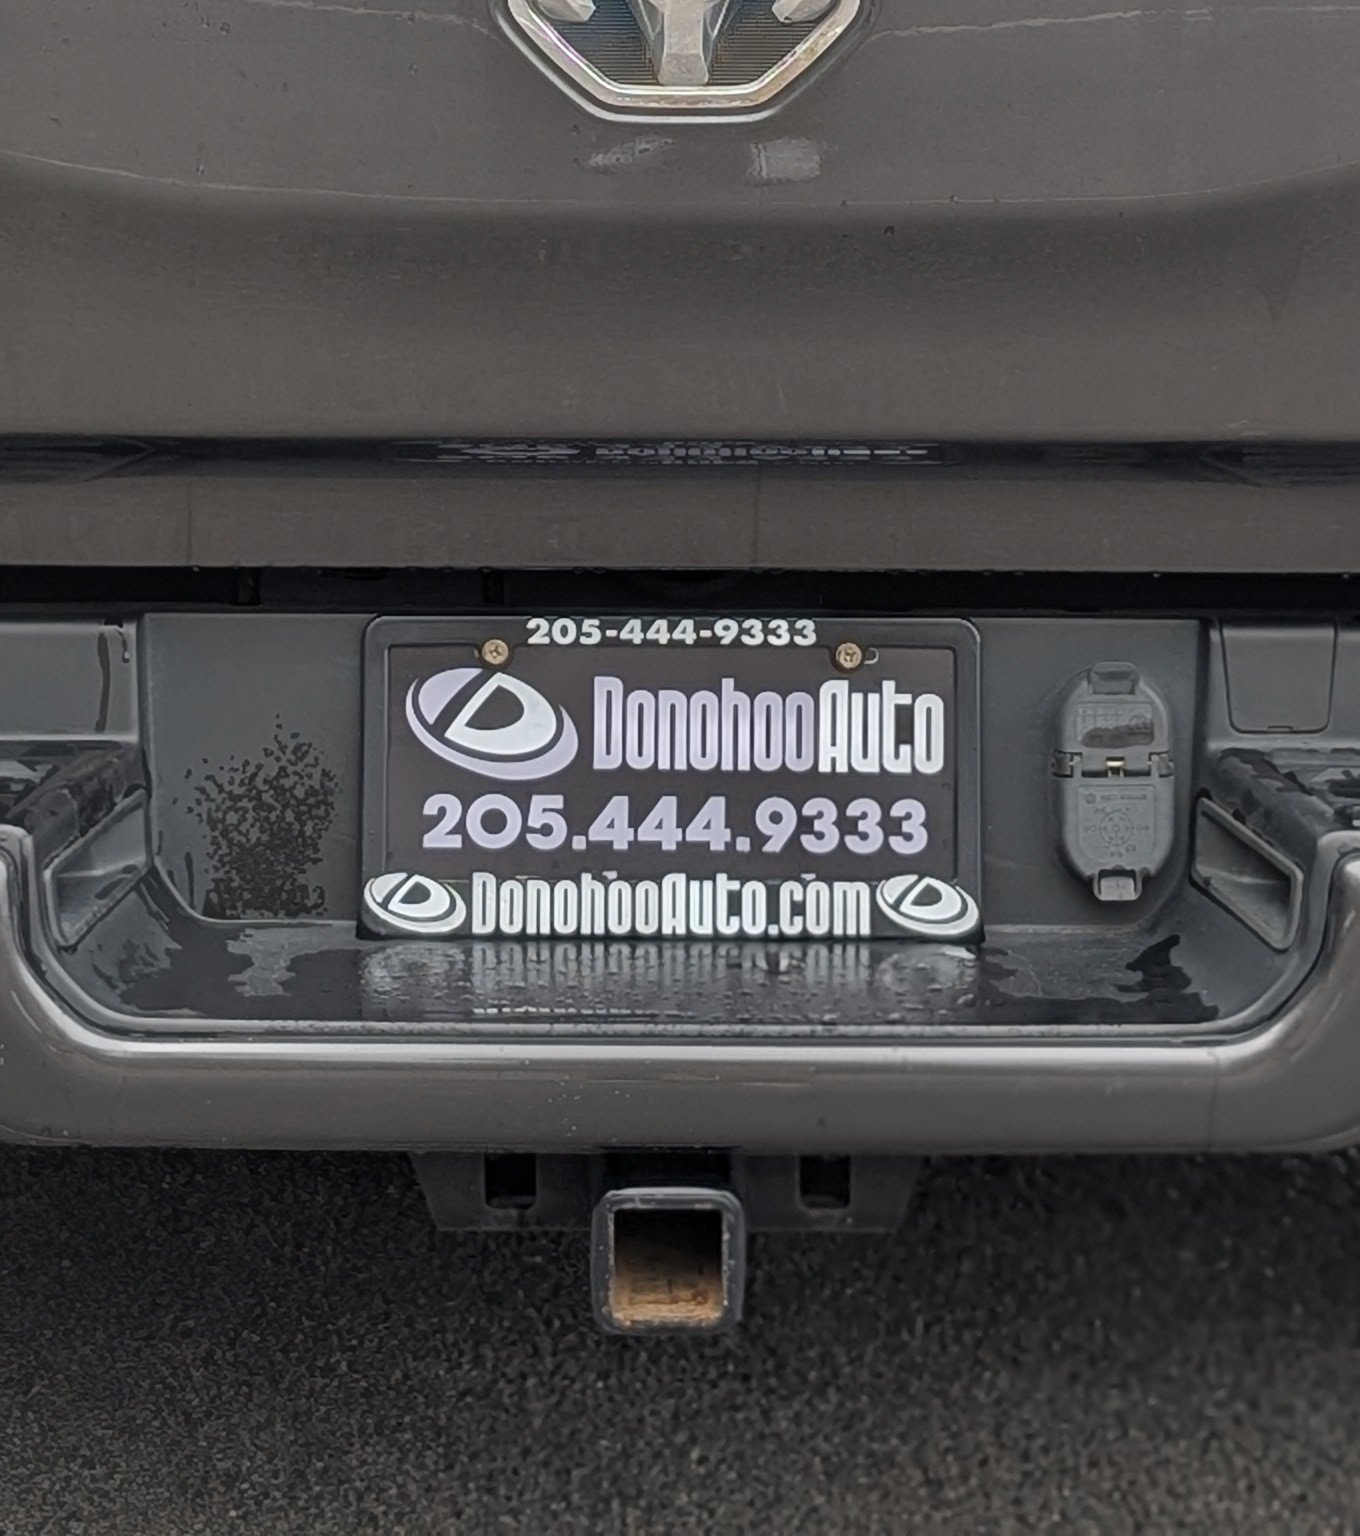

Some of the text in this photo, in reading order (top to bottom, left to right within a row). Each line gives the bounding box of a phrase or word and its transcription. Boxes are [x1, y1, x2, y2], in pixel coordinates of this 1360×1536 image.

[526, 618, 817, 646] 205-444-9333
[592, 676, 945, 775] DonohooAuto
[422, 793, 929, 854] 205.444.9333
[472, 872, 871, 936] DonohooAuto.com
